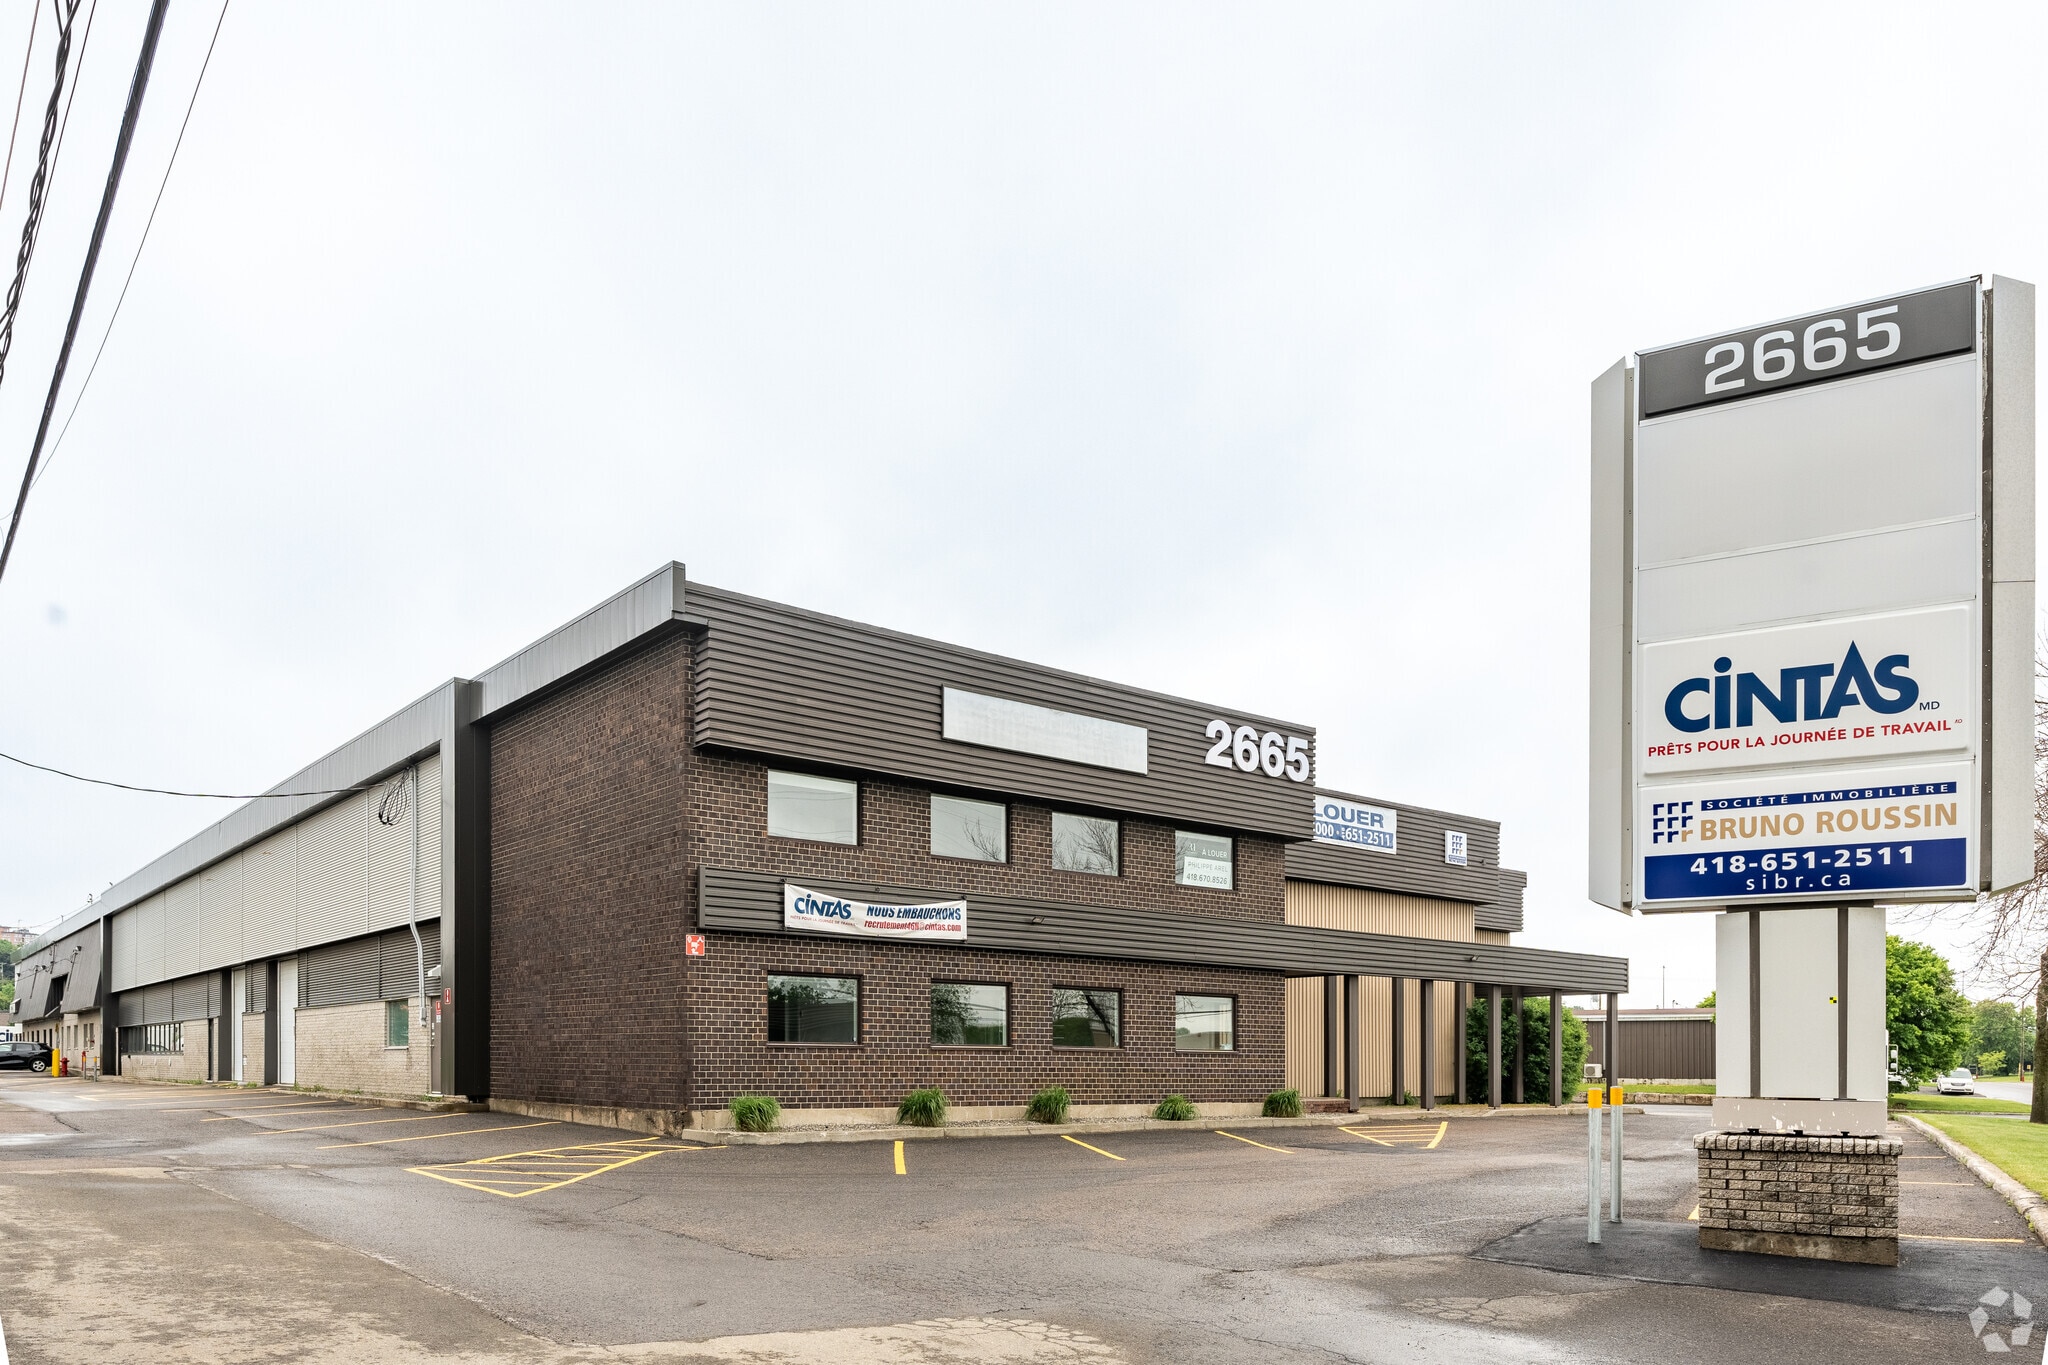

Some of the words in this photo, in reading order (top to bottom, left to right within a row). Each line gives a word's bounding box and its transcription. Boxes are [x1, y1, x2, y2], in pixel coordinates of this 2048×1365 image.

[1704, 305, 1901, 395] 2665
[1919, 701, 1940, 711] MD
[1205, 720, 1310, 782] 2665
[1648, 742, 1692, 757] PRÊTS
[1698, 738, 1740, 752] POUR
[1746, 736, 1765, 748] LA
[1771, 727, 1847, 746] JOURNÉE
[1853, 726, 1875, 739] DE
[1881, 720, 1951, 736] TRAVAIL
[1706, 794, 1788, 810] SOCIÉTÉ
[1803, 784, 1949, 802] IMMOBILIÈRE
[1700, 813, 1805, 841] BRUNO
[1816, 803, 1957, 833] ROUSSIN
[1346, 827, 1390, 846] 651-2511
[1208, 849, 1228, 859] LOUER
[1690, 846, 1913, 875] 418-651-2511
[1746, 872, 1851, 890] sibr.ca
[896, 907, 961, 920] EMBAUCHONS
